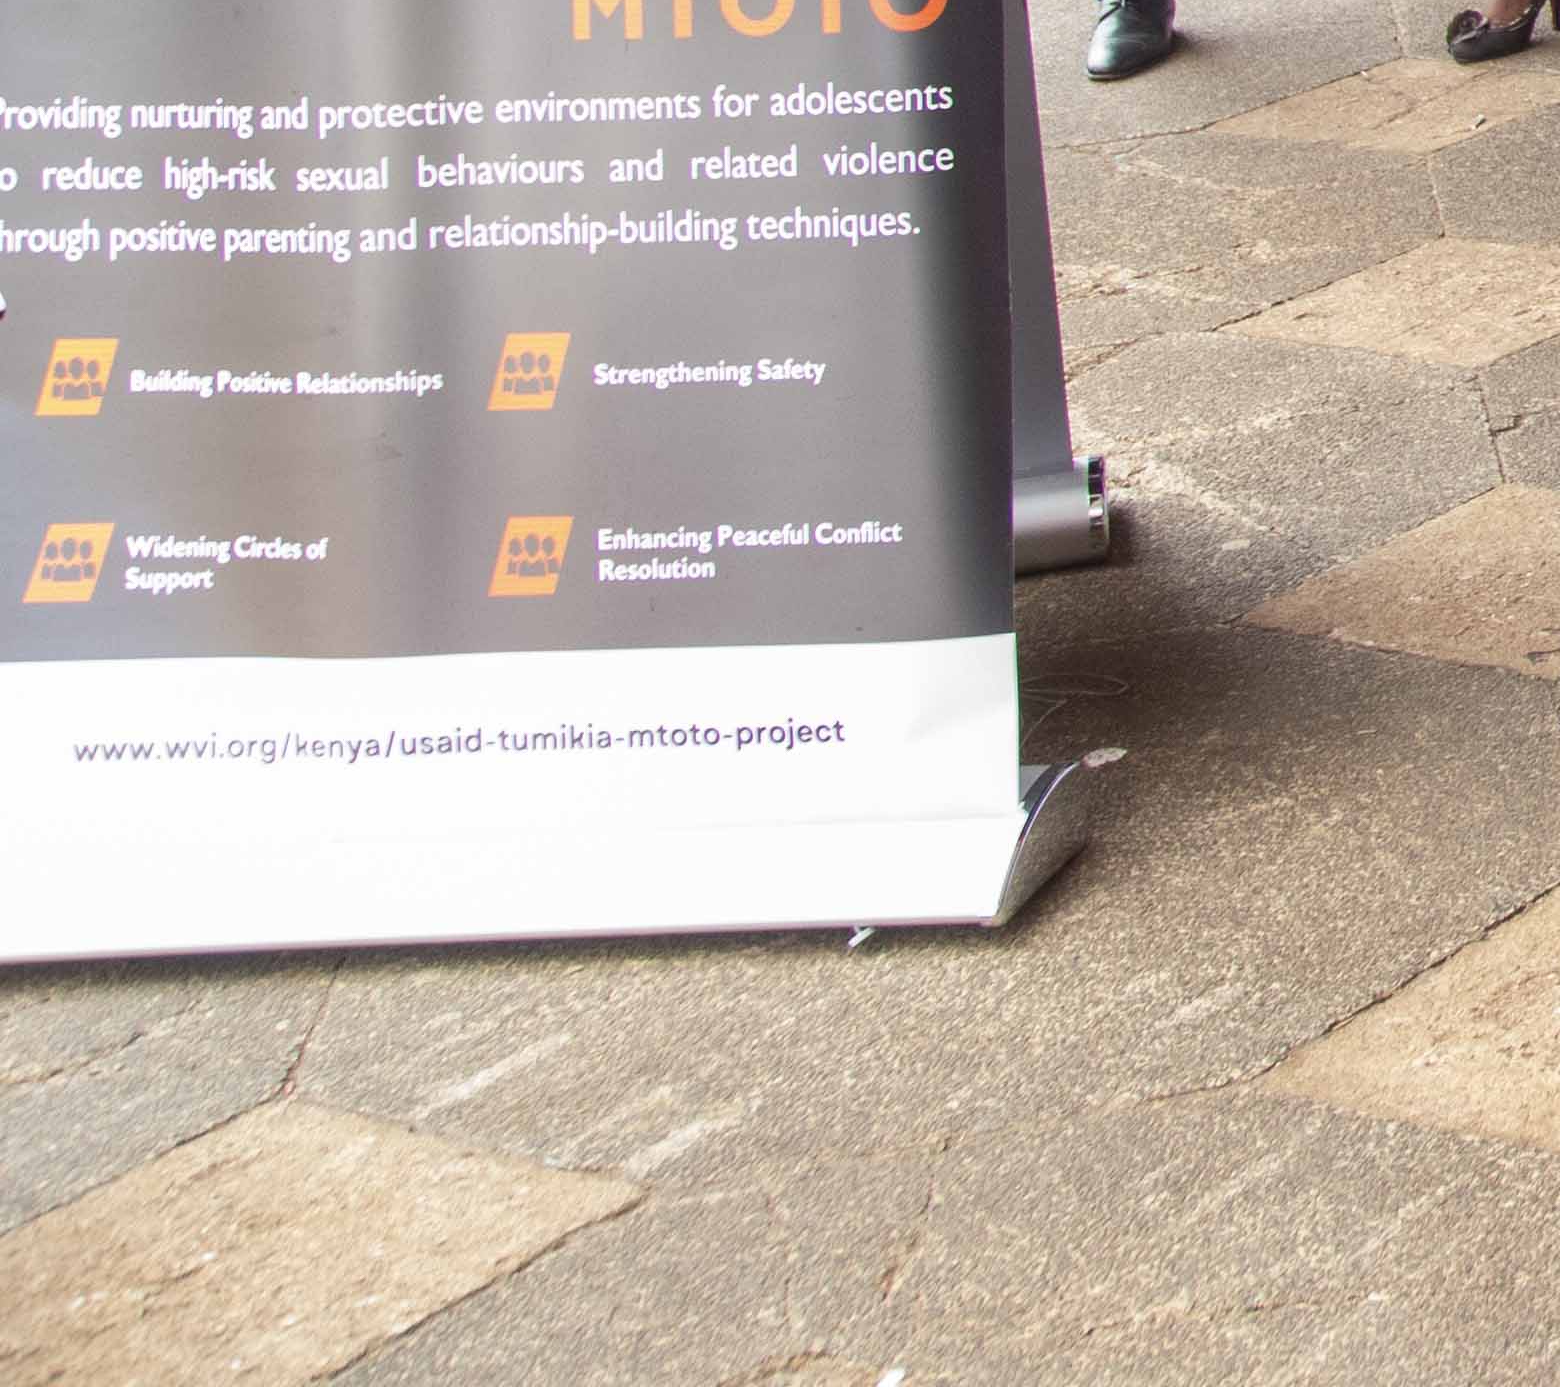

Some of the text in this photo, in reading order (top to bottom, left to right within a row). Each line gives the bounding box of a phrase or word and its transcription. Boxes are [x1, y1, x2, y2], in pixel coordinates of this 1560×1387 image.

[131, 97, 253, 139] nurturing
[260, 96, 309, 130] and
[318, 94, 484, 140] protective
[495, 90, 702, 124] environments
[712, 83, 760, 118] for
[769, 81, 954, 116] adolescents
[42, 141, 955, 200] reduce high-risk sexual behaviours and related violence
[0, 205, 921, 262] hrough positive parenting and relationship-building techniques.
[129, 368, 444, 398] Building Positive Relationships
[593, 358, 826, 390] Strengthening Safety
[126, 535, 329, 564] Widening Circles of
[597, 520, 904, 554] Enhancing Peaceful Conflict
[124, 566, 215, 595] Support
[598, 555, 716, 582] Resolution
[73, 717, 846, 764] www.wvi.org/kenya/usaid-tumikia-mtoto-project
